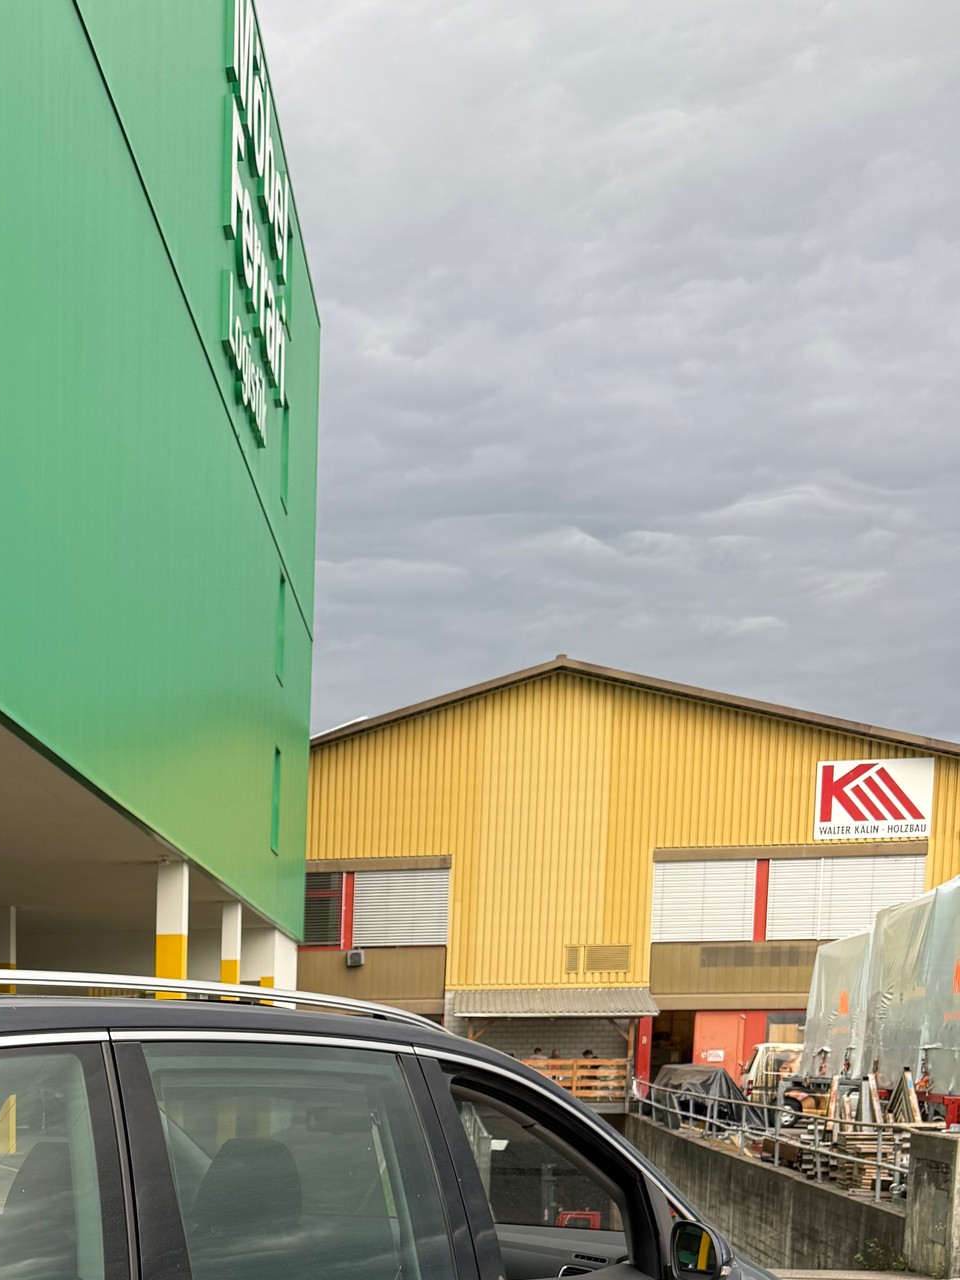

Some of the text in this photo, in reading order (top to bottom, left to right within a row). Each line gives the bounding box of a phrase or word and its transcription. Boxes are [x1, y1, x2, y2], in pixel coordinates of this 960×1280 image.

[230, 93, 286, 407] Ferrari
[229, 271, 267, 447] Logistik
[819, 825, 850, 835] WALTER
[887, 823, 927, 834] HOLZBAU
